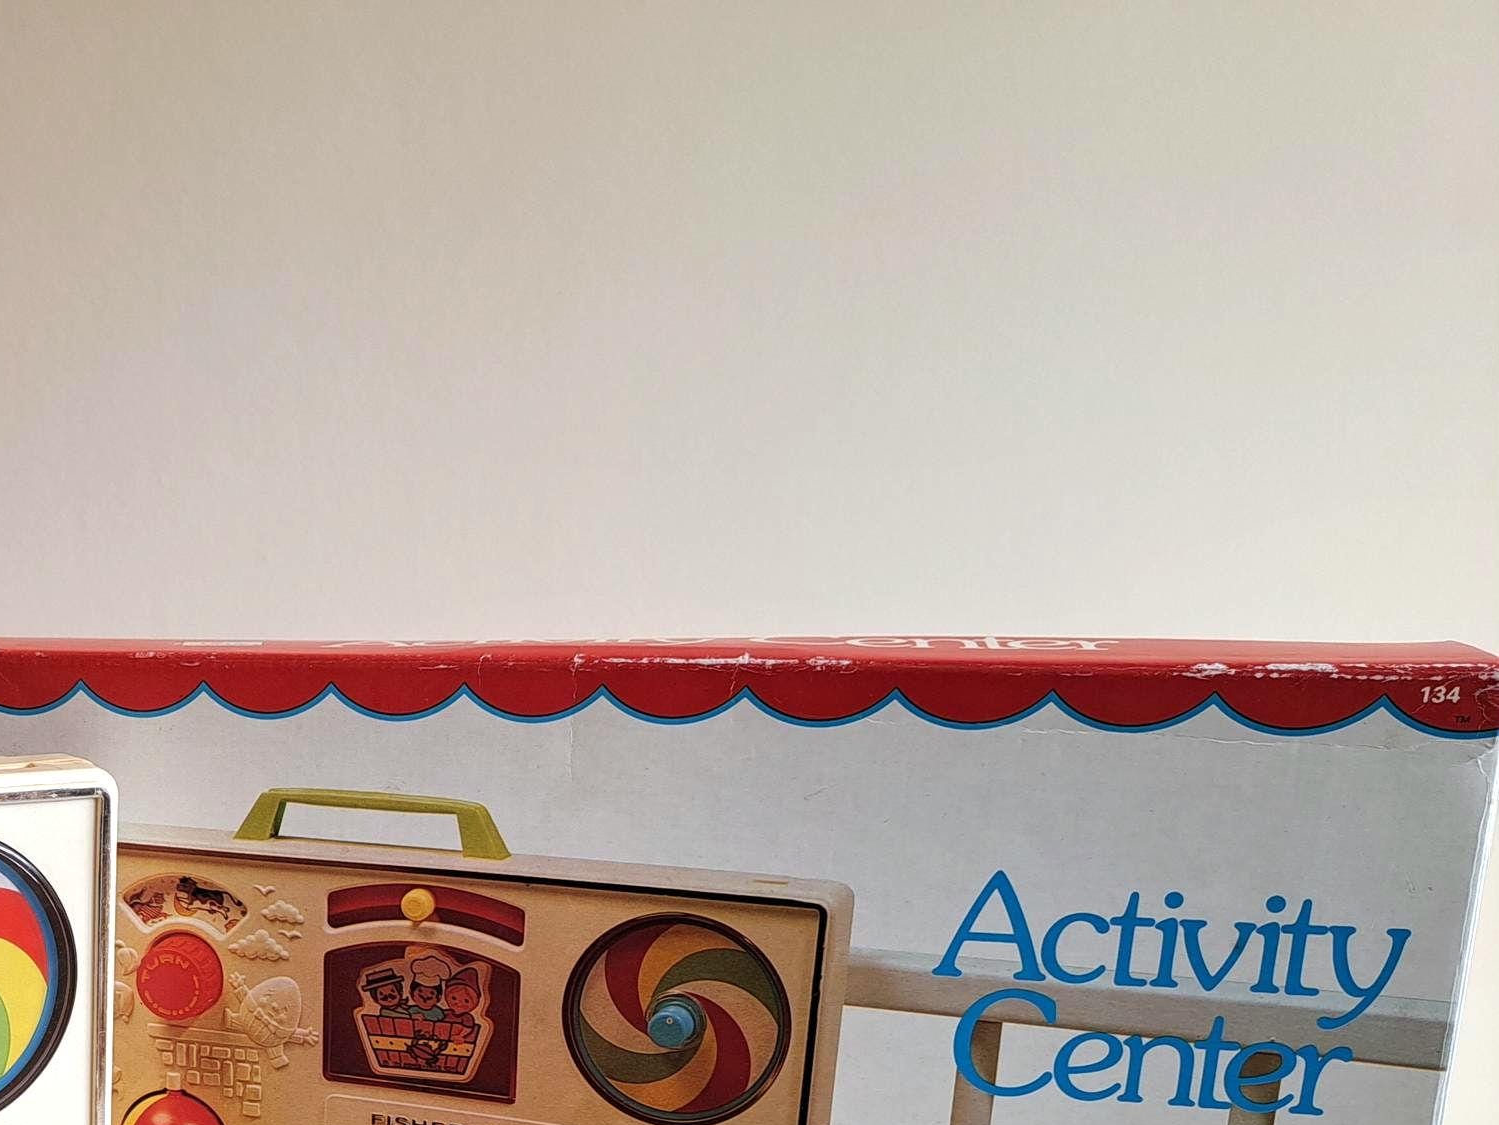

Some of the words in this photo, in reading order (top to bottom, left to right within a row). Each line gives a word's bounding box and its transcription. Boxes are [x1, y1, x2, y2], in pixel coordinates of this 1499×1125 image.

[749, 635, 1120, 650] enter
[1421, 686, 1460, 703] 134
[931, 869, 1412, 1030] Activity
[953, 987, 1353, 1117] Center
